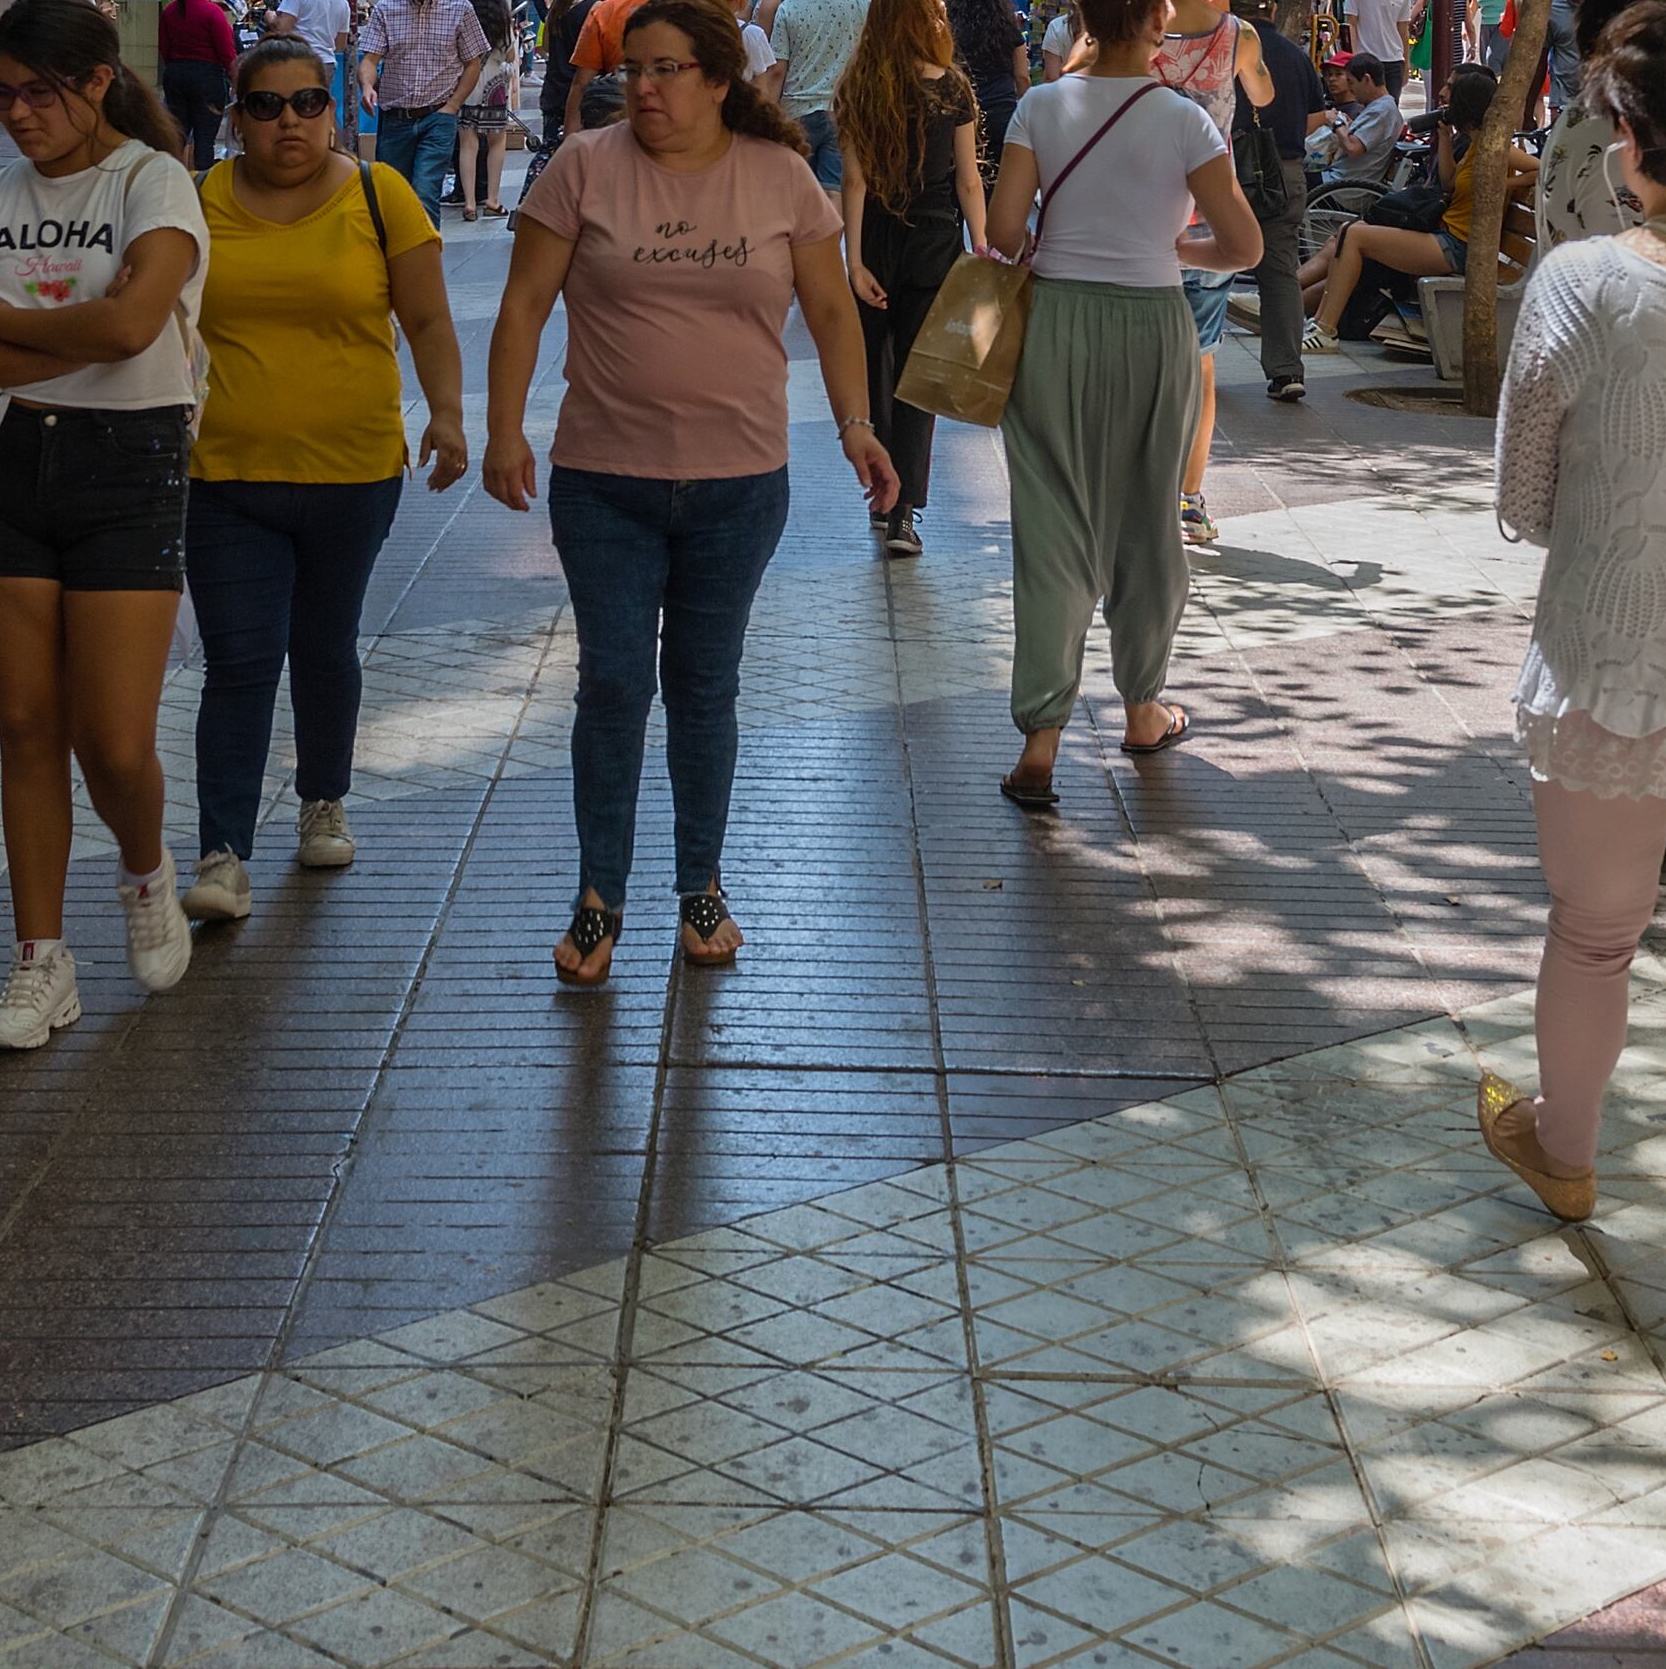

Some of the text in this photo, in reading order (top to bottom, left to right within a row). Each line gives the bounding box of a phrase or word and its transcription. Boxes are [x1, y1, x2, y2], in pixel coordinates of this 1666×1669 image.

[655, 220, 697, 239] no
[633, 236, 756, 269] excuses
[15, 254, 83, 276] Hawaii
